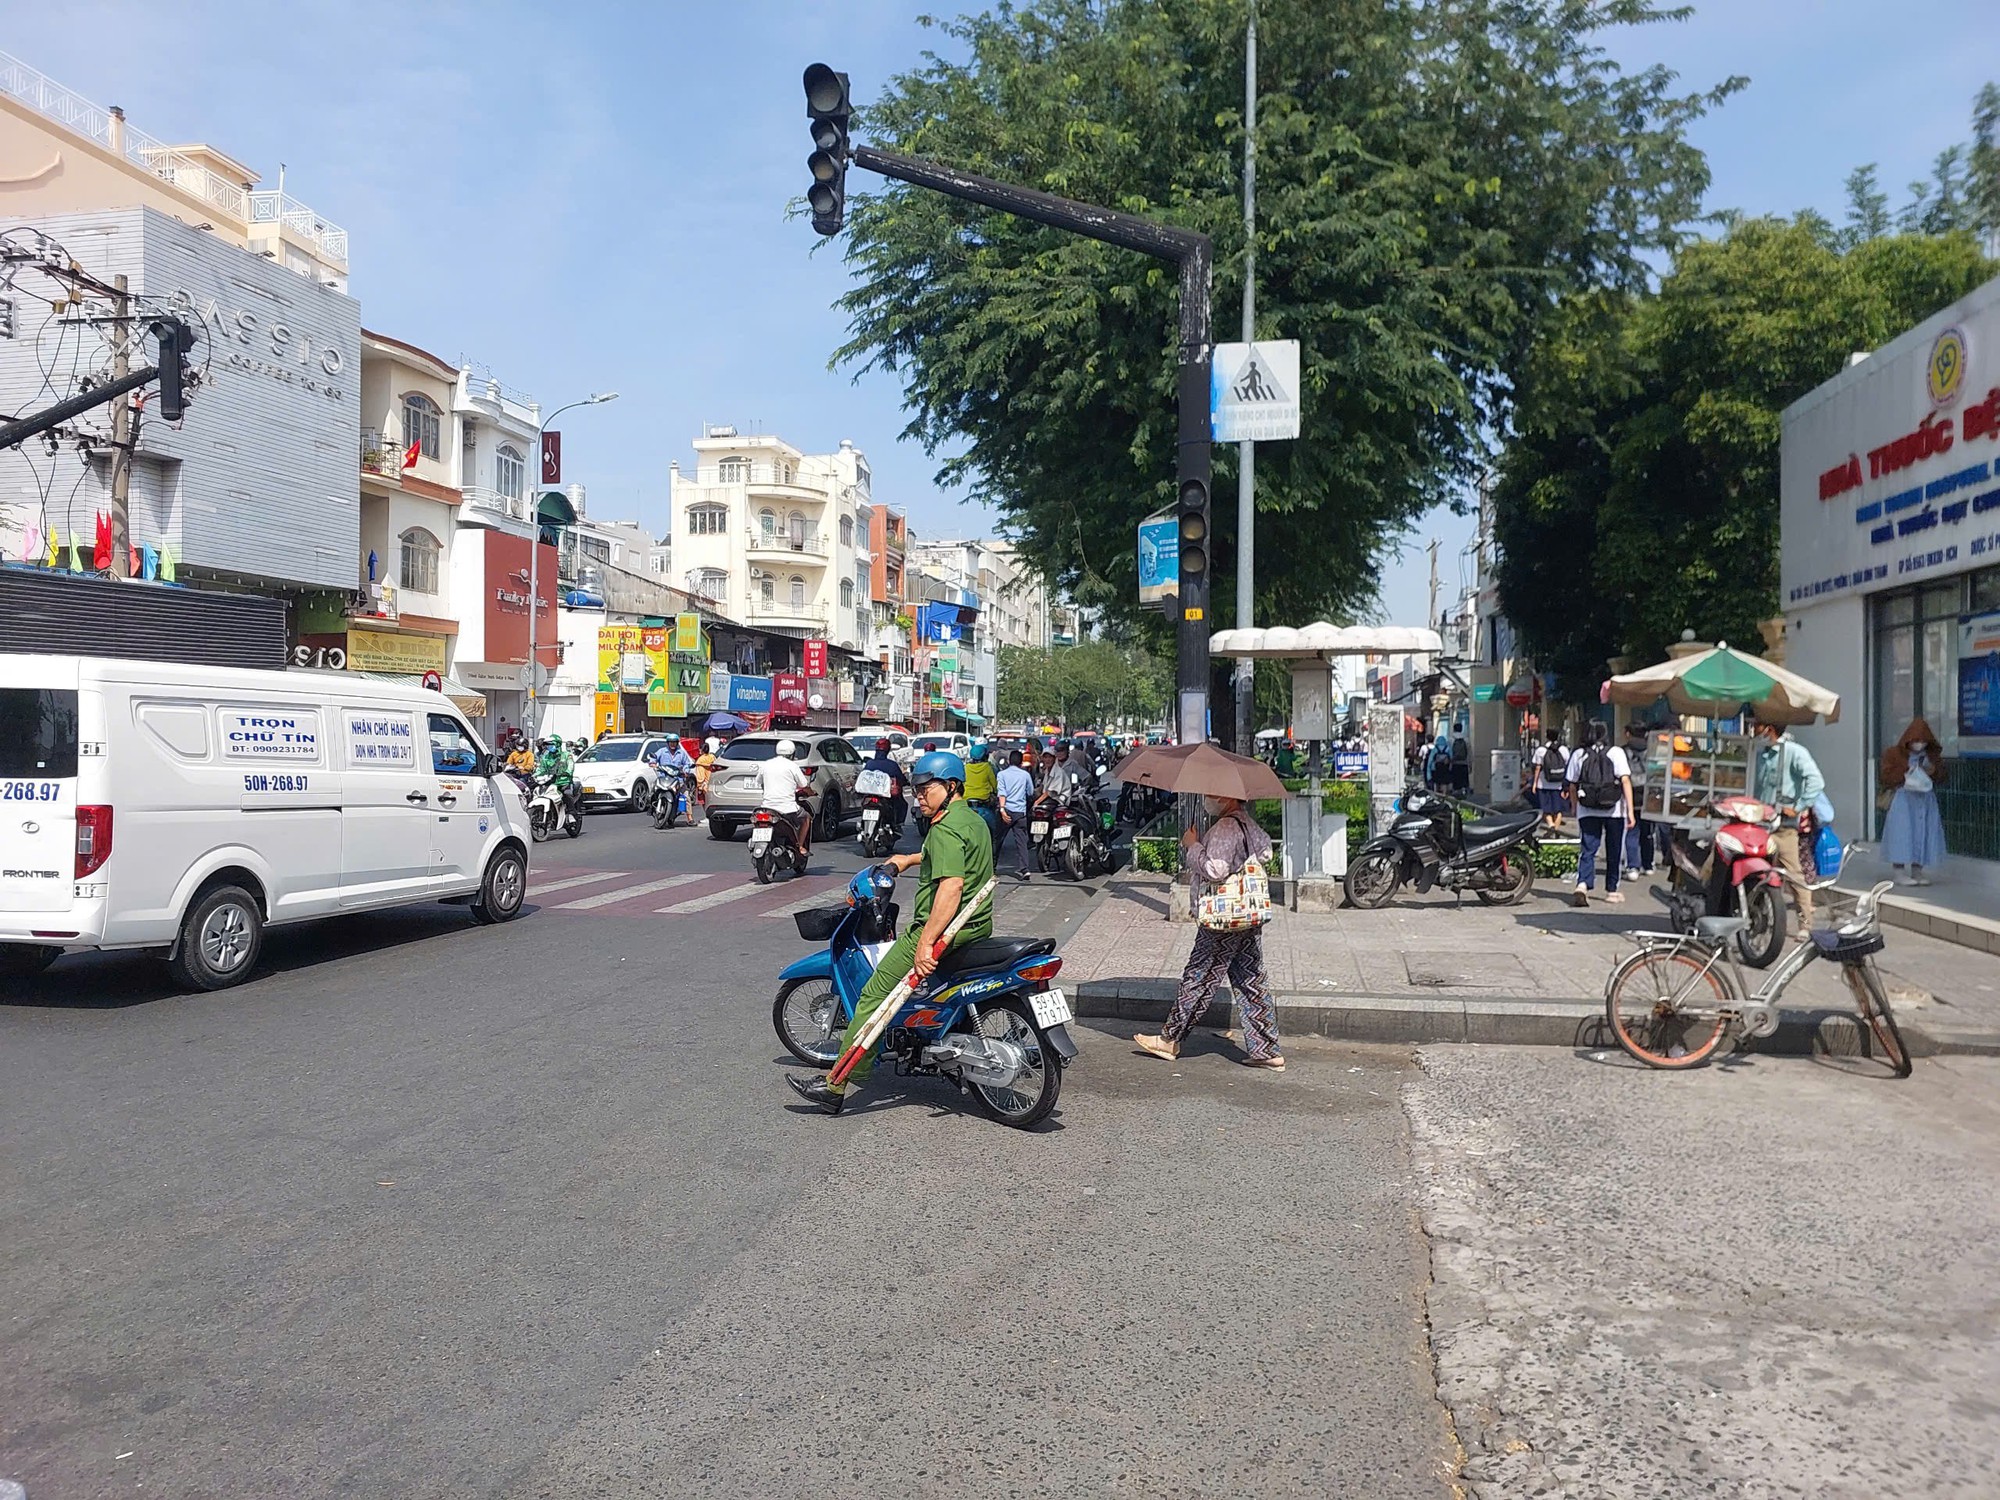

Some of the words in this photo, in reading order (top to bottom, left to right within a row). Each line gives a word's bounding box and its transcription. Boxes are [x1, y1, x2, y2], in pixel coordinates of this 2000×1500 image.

[1819, 453, 1863, 501] NHÀ
[1867, 410, 1954, 480] THUỐC
[736, 685, 767, 702] vinaphone
[236, 717, 295, 729] TRỌN
[351, 720, 372, 739] NHẬN
[374, 717, 388, 737] CHỞ
[390, 722, 410, 737] HÀNG
[229, 730, 275, 742] CHỮ
[282, 731, 315, 743] TÍN
[232, 745, 250, 753] ĐT:
[253, 745, 315, 754] 0909231784
[355, 744, 366, 762] DỌN
[366, 743, 377, 759] NHÀ
[377, 745, 391, 762] TRỌN
[391, 742, 399, 759] GÓI
[400, 745, 411, 760] 24/7
[244, 775, 308, 791] 50H-268.97
[2, 869, 60, 879] FRONTIER
[961, 980, 1001, 998] Wave
[1034, 990, 1062, 1010] 59-X1
